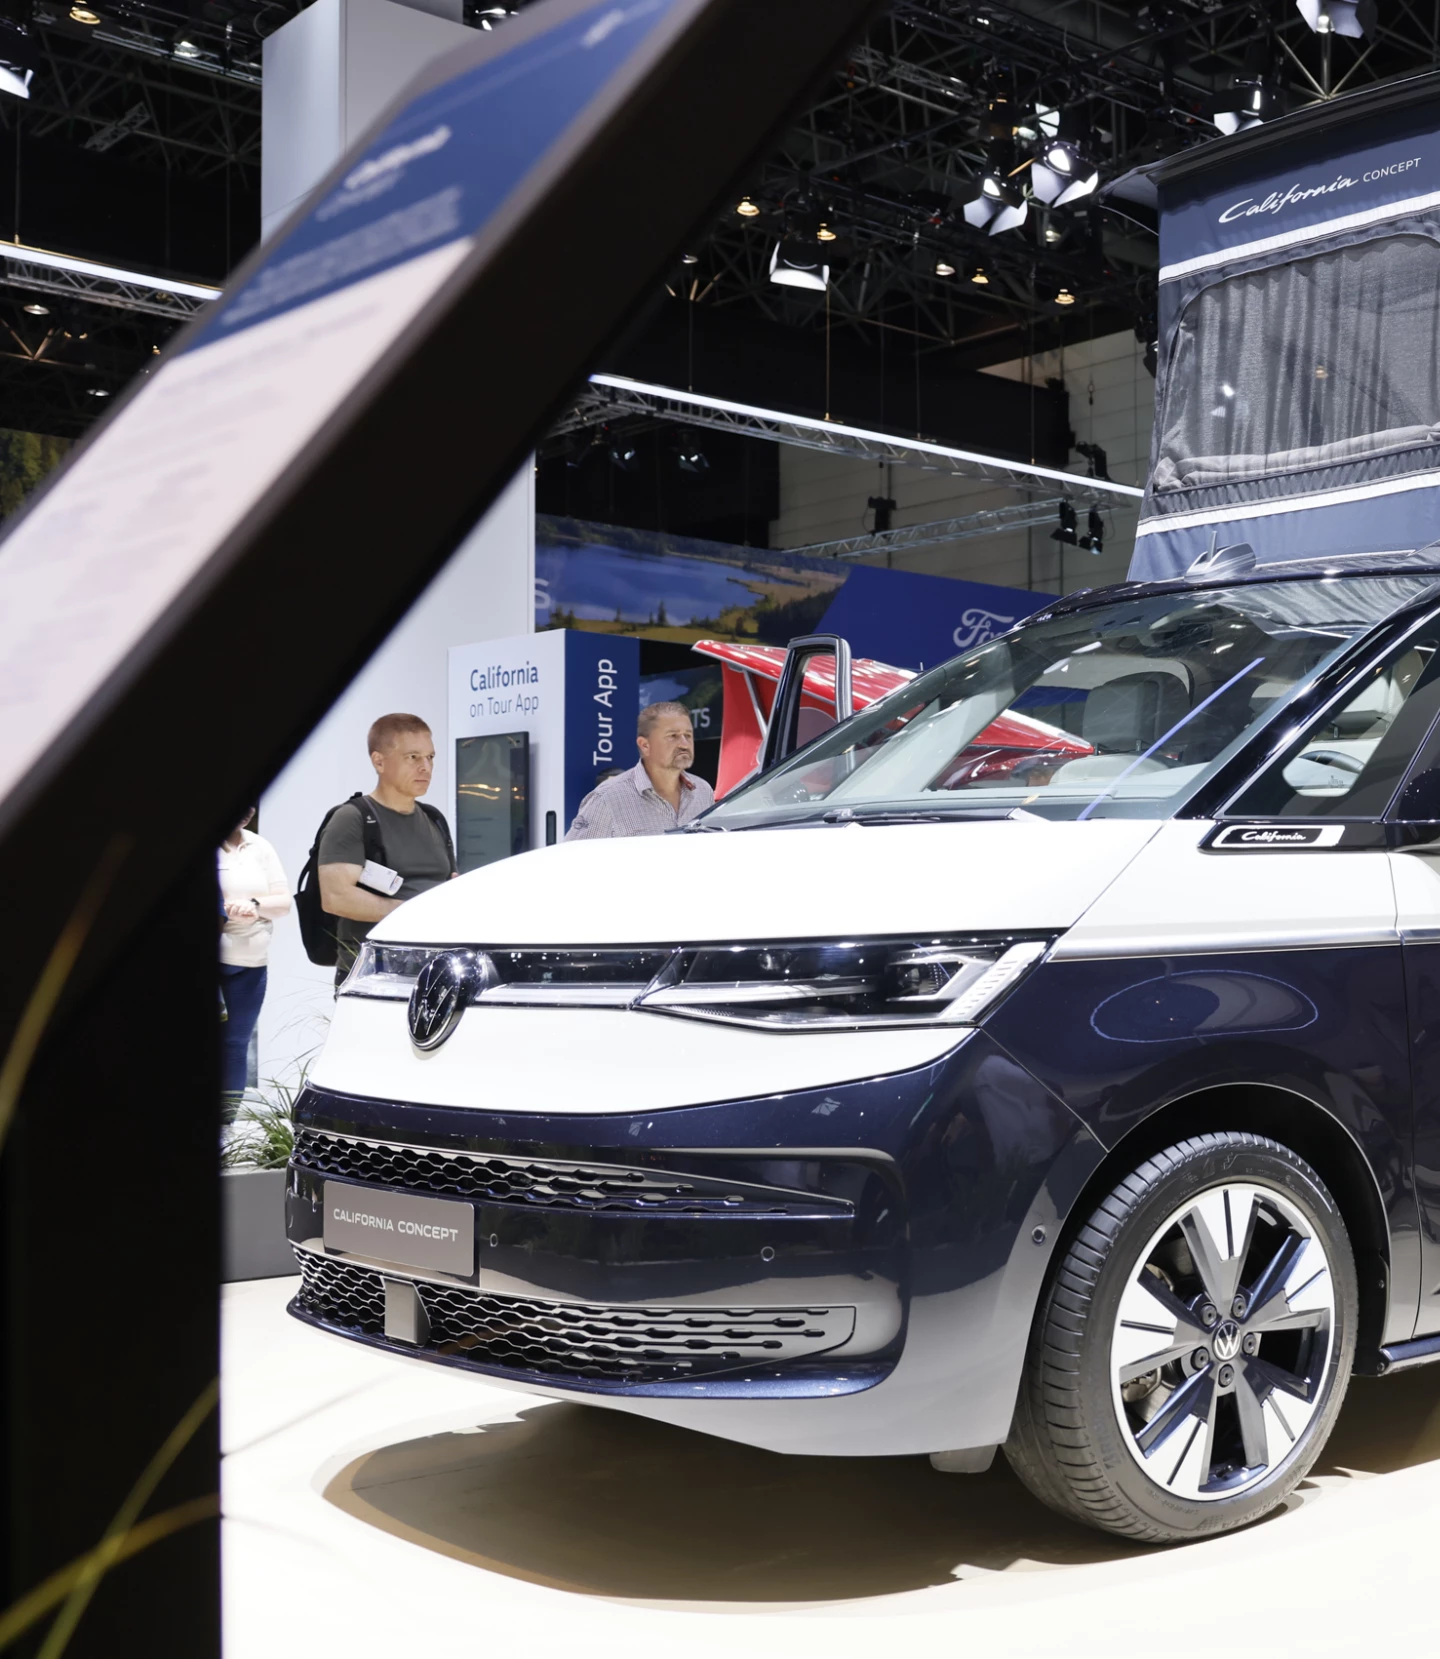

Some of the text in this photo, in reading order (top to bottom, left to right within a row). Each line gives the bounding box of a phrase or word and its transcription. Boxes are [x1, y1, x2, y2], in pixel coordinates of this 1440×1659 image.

[1218, 157, 1422, 224] California CONCEPT
[470, 660, 539, 692] California
[469, 693, 539, 718] on Tour App
[593, 658, 618, 766] Tour App
[1241, 831, 1307, 842] California
[333, 1208, 458, 1242] CALIFORNIA CONCEPT
